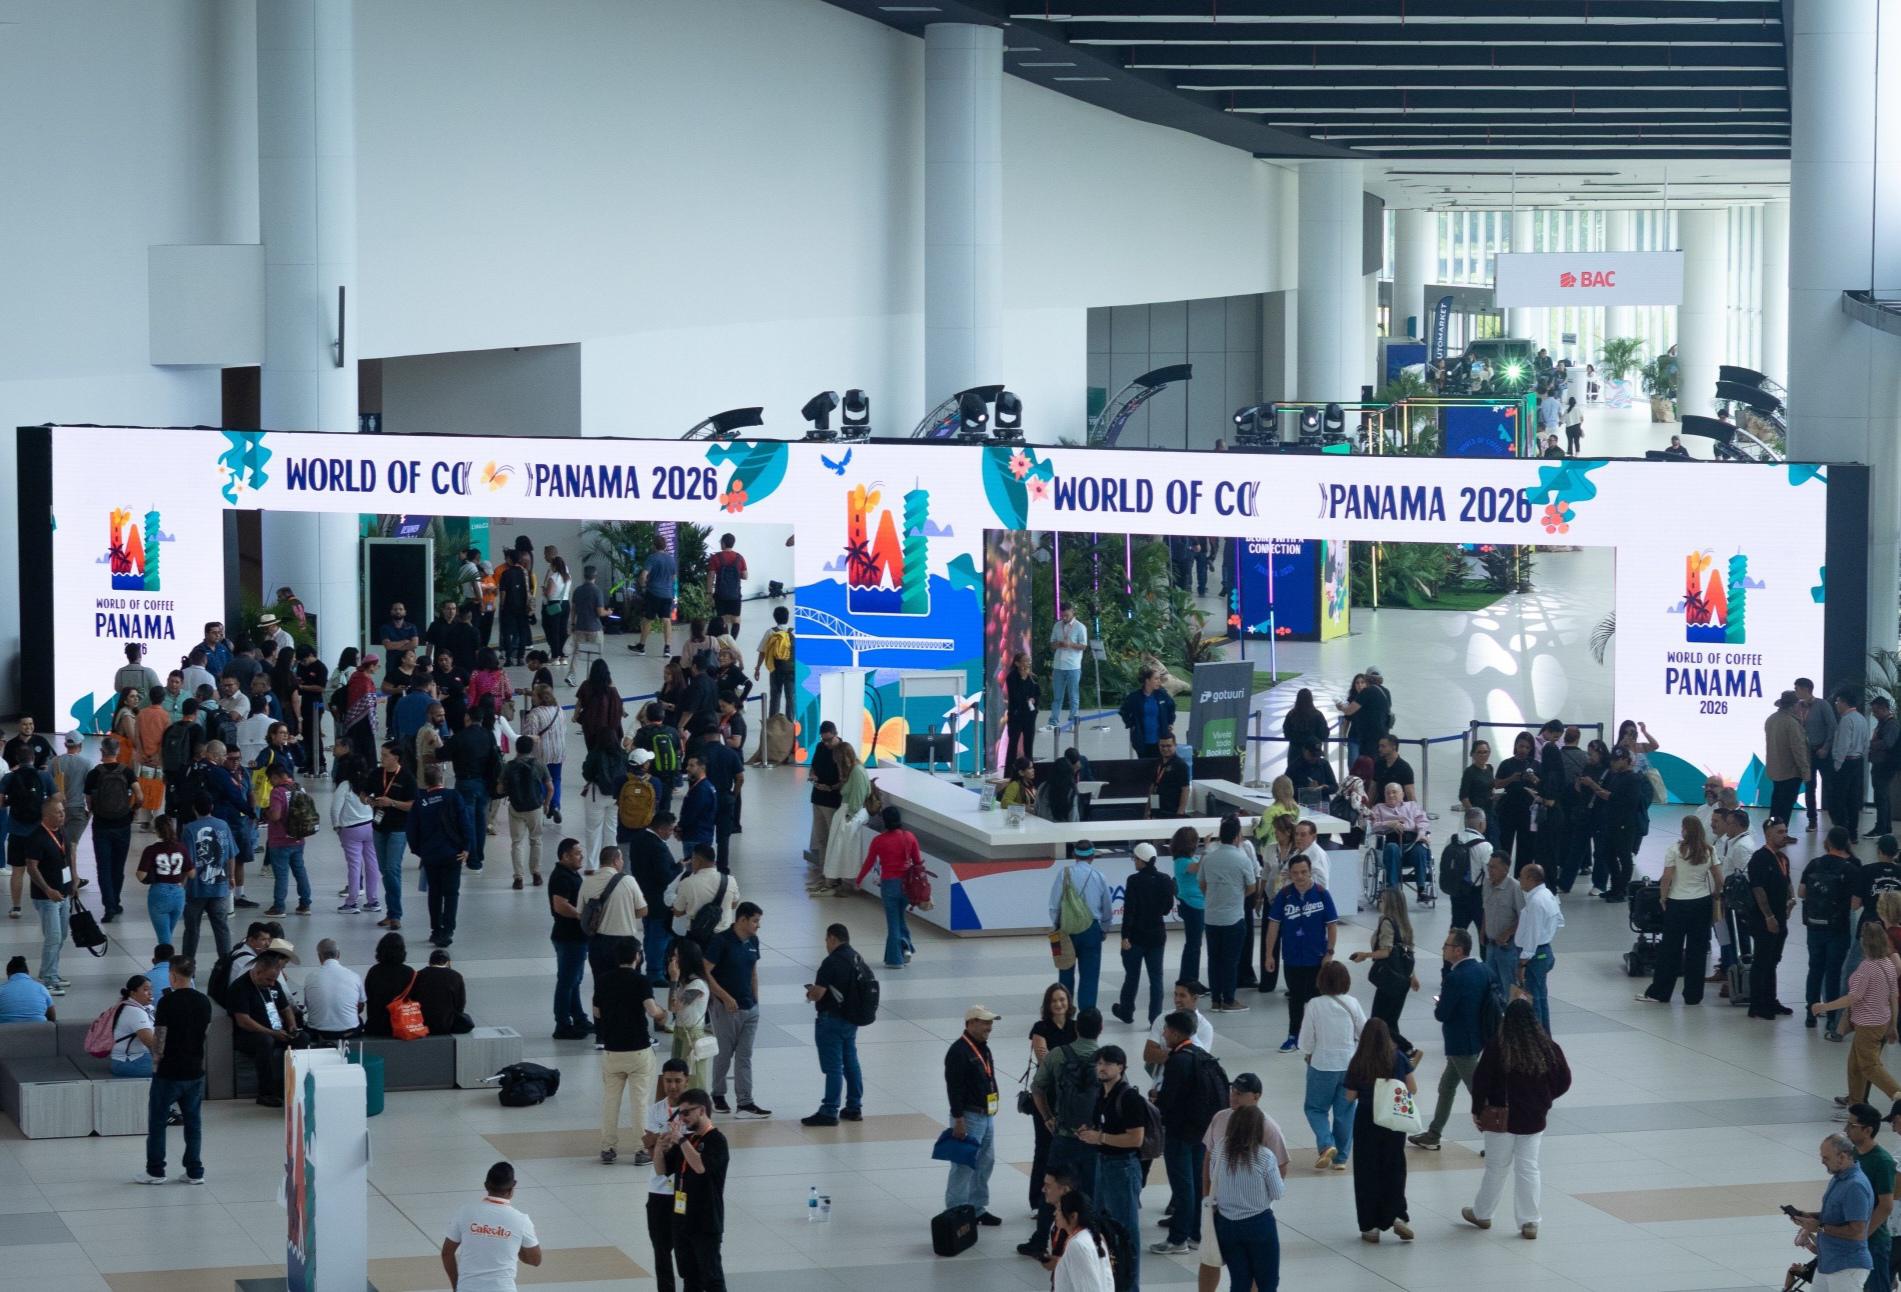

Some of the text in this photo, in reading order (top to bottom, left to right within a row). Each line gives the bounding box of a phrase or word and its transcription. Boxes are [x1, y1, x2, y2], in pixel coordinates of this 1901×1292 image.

[1580, 271, 1616, 288] BAC
[1437, 302, 1448, 360] UTOMARKET
[286, 457, 377, 493] WORLD
[387, 460, 421, 494] OF
[535, 463, 718, 501] PANAMA 2026
[1054, 476, 1154, 513] WORLD
[1166, 479, 1203, 515] OF
[1329, 484, 1533, 523] PANAMA 2026
[1248, 543, 1301, 555] CONNECTION
[96, 598, 175, 611] WORLD OF COFFEE
[95, 612, 176, 640] PANAMA
[1667, 651, 1763, 666] WORLD OF COFFEE
[1665, 667, 1763, 698] PANAMA
[1212, 688, 1245, 703] gotuuri
[1700, 700, 1728, 715] 2026
[1283, 900, 1325, 918] Dodgers
[470, 1222, 512, 1237] Cafecito
